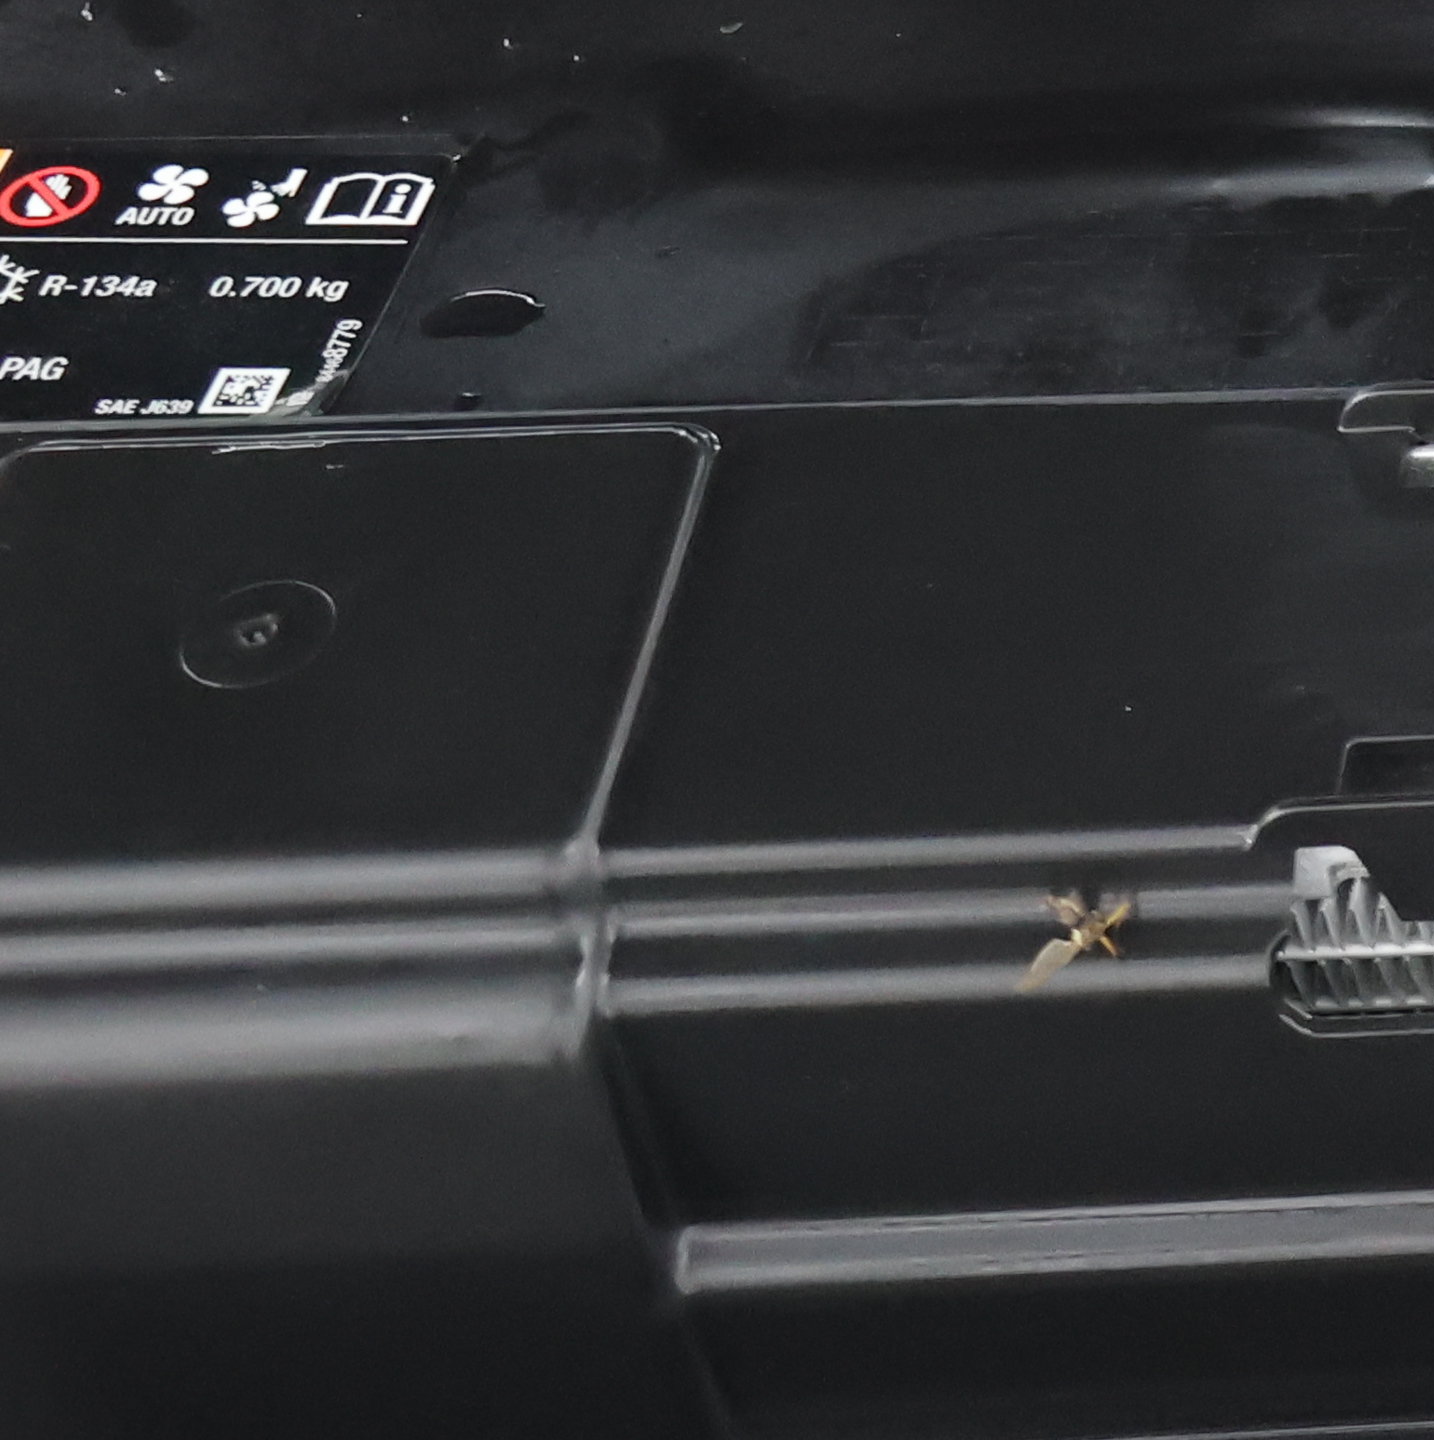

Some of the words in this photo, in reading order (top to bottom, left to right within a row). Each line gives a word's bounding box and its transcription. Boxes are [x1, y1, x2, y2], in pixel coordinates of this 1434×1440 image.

[115, 206, 195, 226] AUTO
[39, 276, 158, 298] R-134a
[209, 276, 301, 298] 0.700
[305, 277, 349, 302] kg
[0, 356, 69, 381] PAG
[94, 398, 137, 415] SAE
[140, 398, 194, 415] J639
